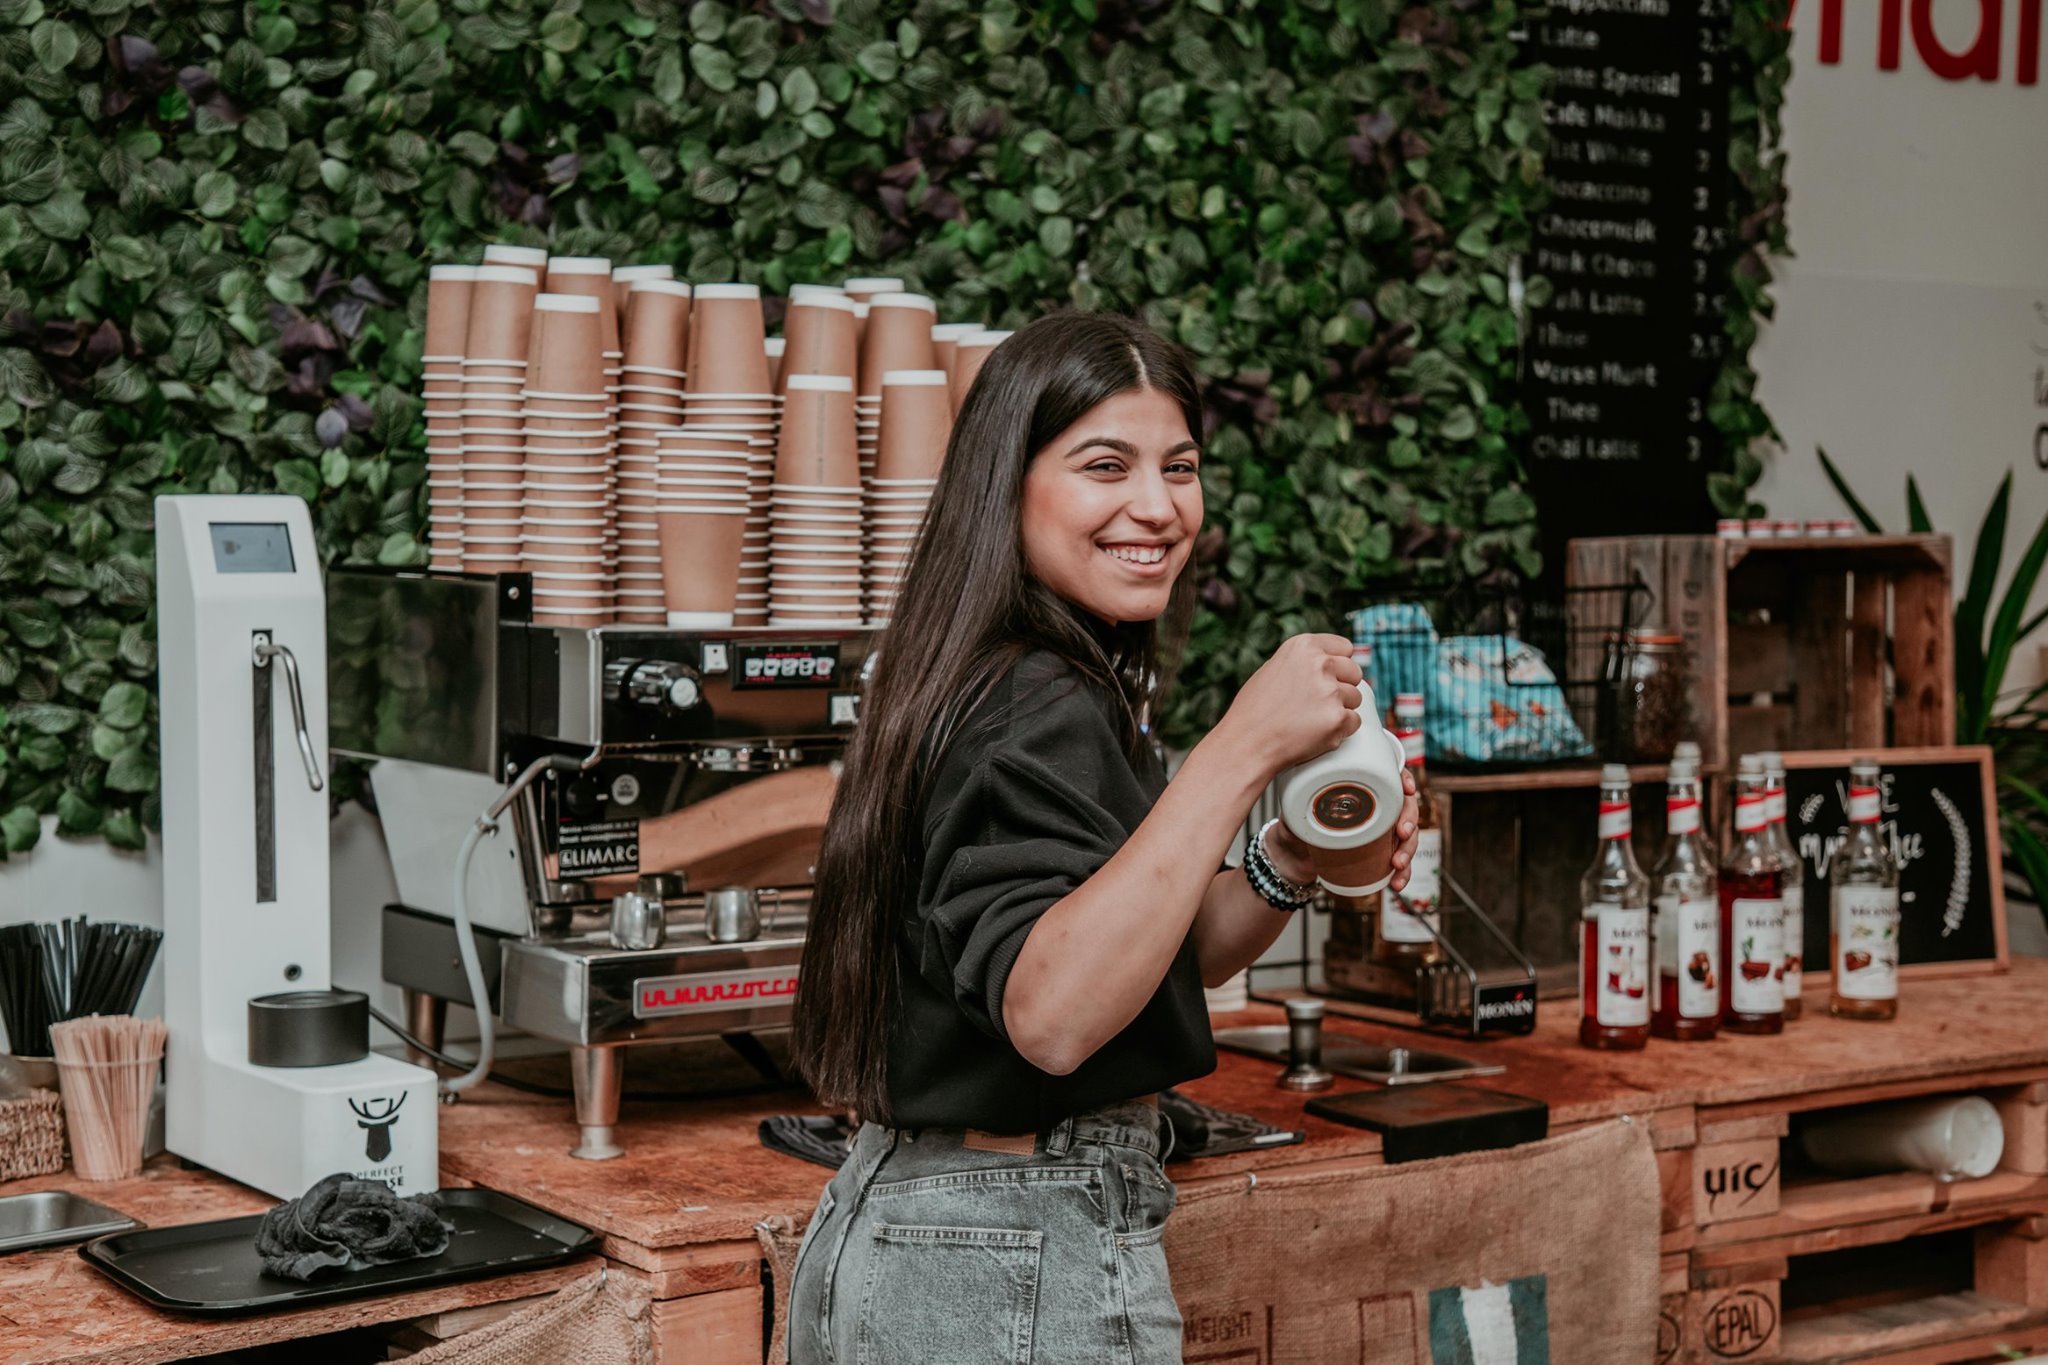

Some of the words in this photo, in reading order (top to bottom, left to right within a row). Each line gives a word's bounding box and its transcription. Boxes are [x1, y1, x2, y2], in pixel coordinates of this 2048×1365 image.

[573, 844, 638, 866] LIMARC
[1478, 1000, 1535, 1020] MONIN
[357, 1165, 404, 1178] PERFECT
[1184, 1311, 1252, 1344] WEIGHT
[1716, 1301, 1762, 1348] EPAL
